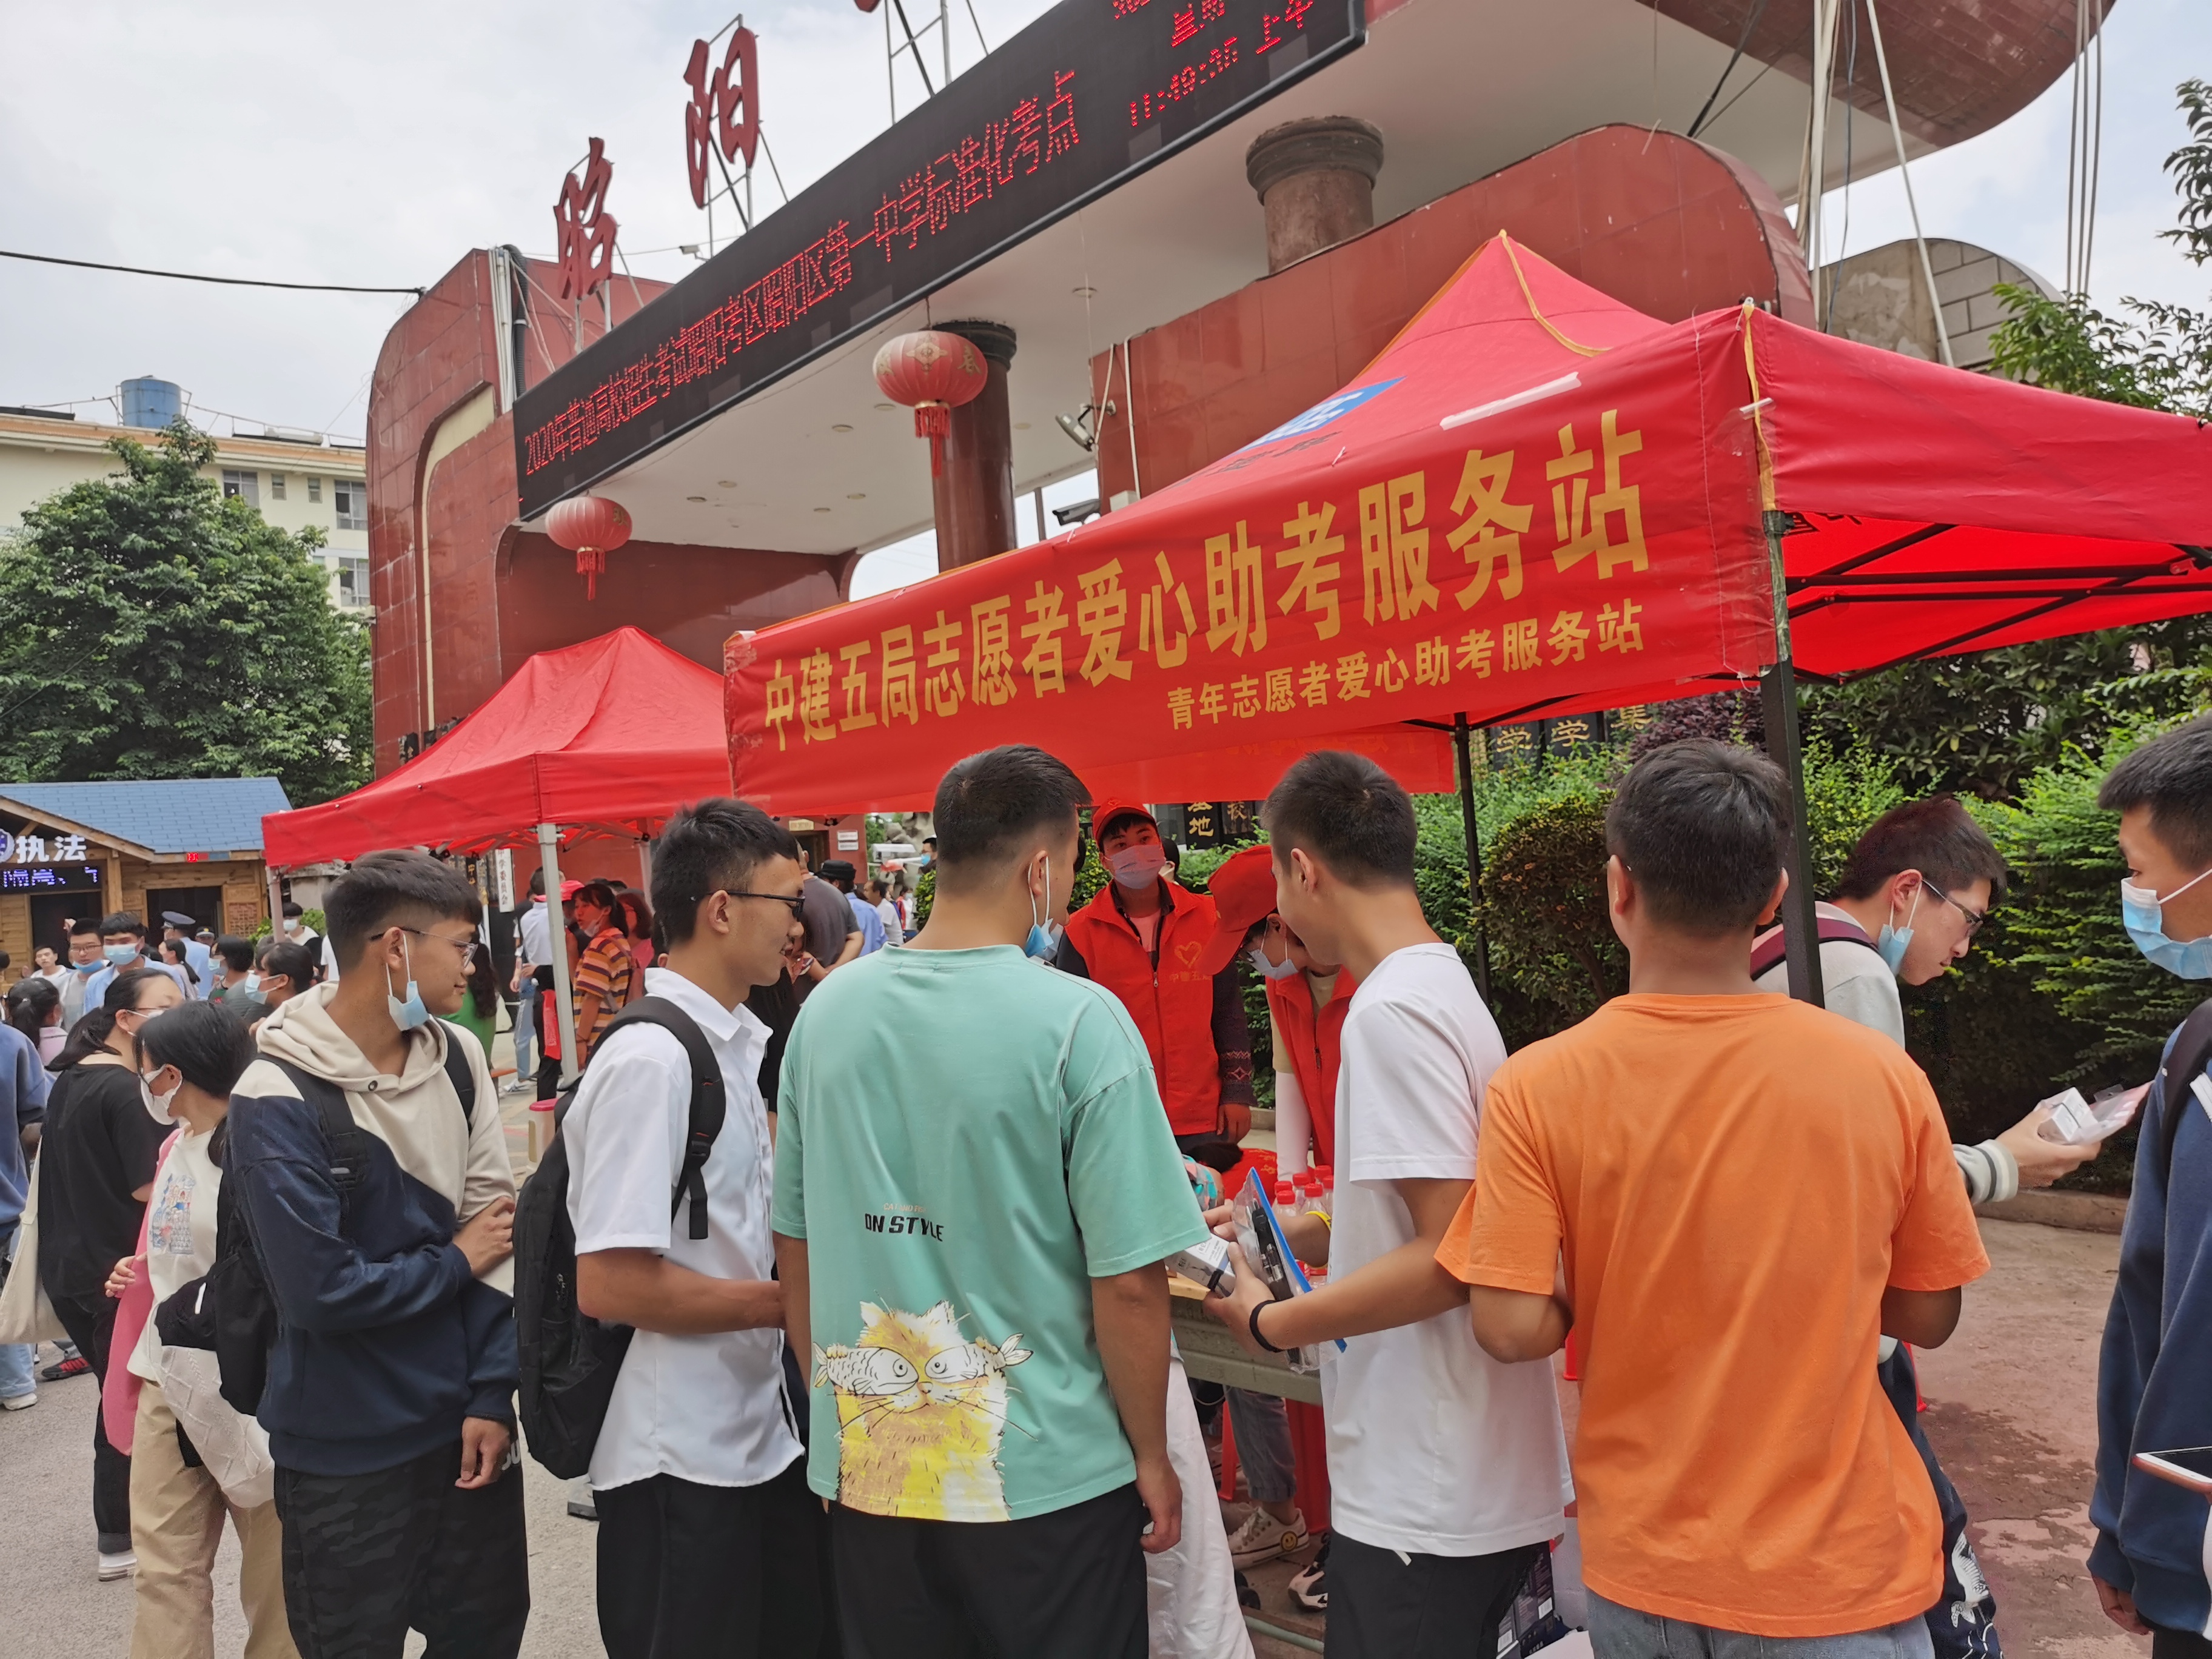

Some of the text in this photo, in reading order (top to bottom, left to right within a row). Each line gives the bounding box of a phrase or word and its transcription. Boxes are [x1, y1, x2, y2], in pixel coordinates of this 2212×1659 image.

[765, 409, 1649, 751] 中建五局志愿者爱心助考服务站
[1167, 598, 1644, 730] 青年志愿者爱心助考服务站
[16, 834, 87, 863] 执法
[865, 1213, 944, 1242] ON STYLE
